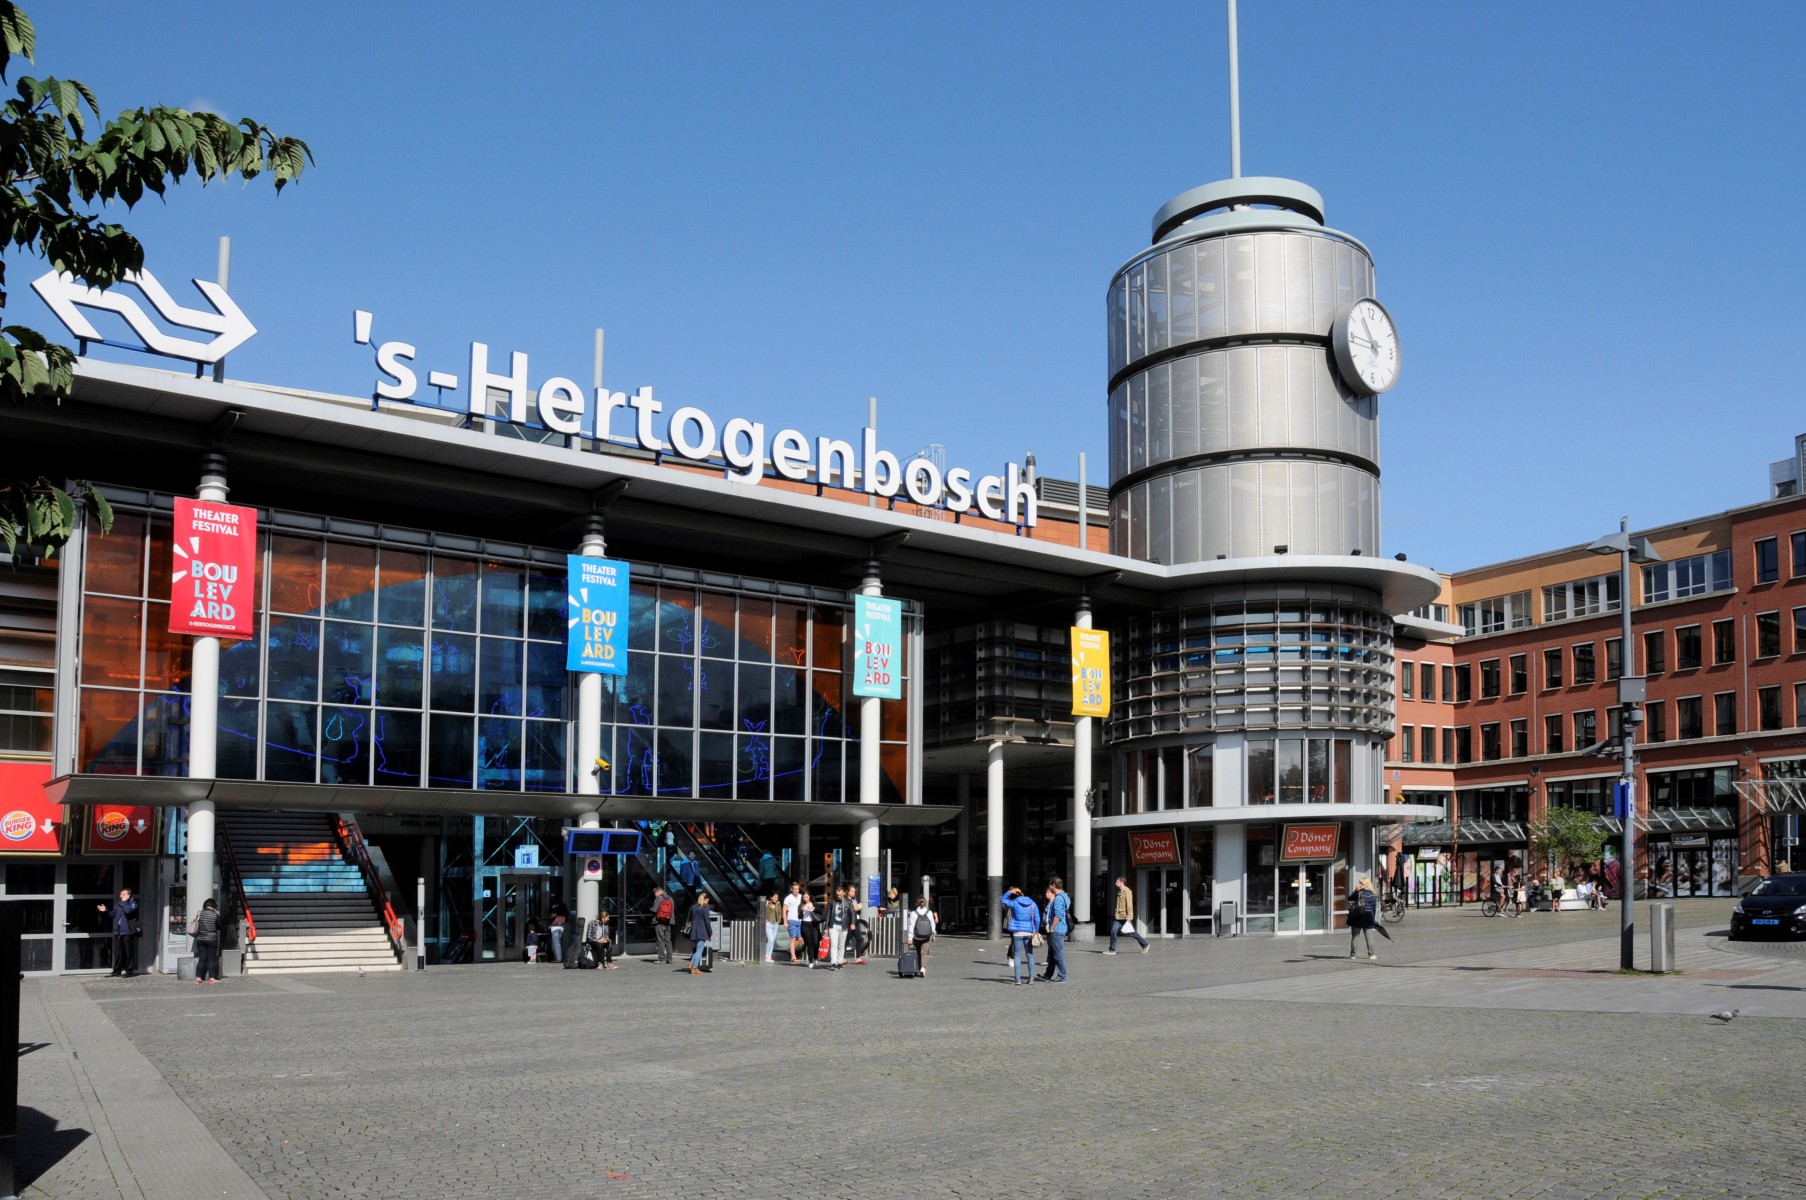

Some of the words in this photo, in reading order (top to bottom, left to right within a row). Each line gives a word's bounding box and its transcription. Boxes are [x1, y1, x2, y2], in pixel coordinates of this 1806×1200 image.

[1367, 307, 1375, 321] 12
[1350, 331, 1355, 343] 9
[1388, 348, 1393, 360] 3
[1370, 372, 1375, 384] 6
[354, 309, 1037, 527] 's-Hertogenbosch
[192, 507, 239, 525] THEATER
[192, 520, 239, 536] FESTIVAL
[191, 559, 238, 584] BOU
[581, 563, 617, 576] THEATER
[581, 573, 617, 586] FESTIVAL
[193, 579, 234, 602] LEV
[189, 599, 236, 621] ARD
[865, 601, 892, 613] THEATER
[581, 607, 617, 627] BOU
[865, 610, 892, 622] FESTIVAL
[584, 625, 613, 643] LEV
[581, 642, 615, 660] ARD
[867, 656, 889, 670] LEV
[864, 671, 891, 685] ARD
[1082, 693, 1103, 705] ARD
[4, 816, 31, 827] BURGER
[100, 817, 125, 828] BURGER
[5, 822, 32, 834] KING
[101, 822, 126, 834] KING
[1301, 832, 1333, 843] Döner
[1142, 839, 1171, 849] Döner
[1288, 844, 1331, 854] Company
[1136, 851, 1173, 860] Company
